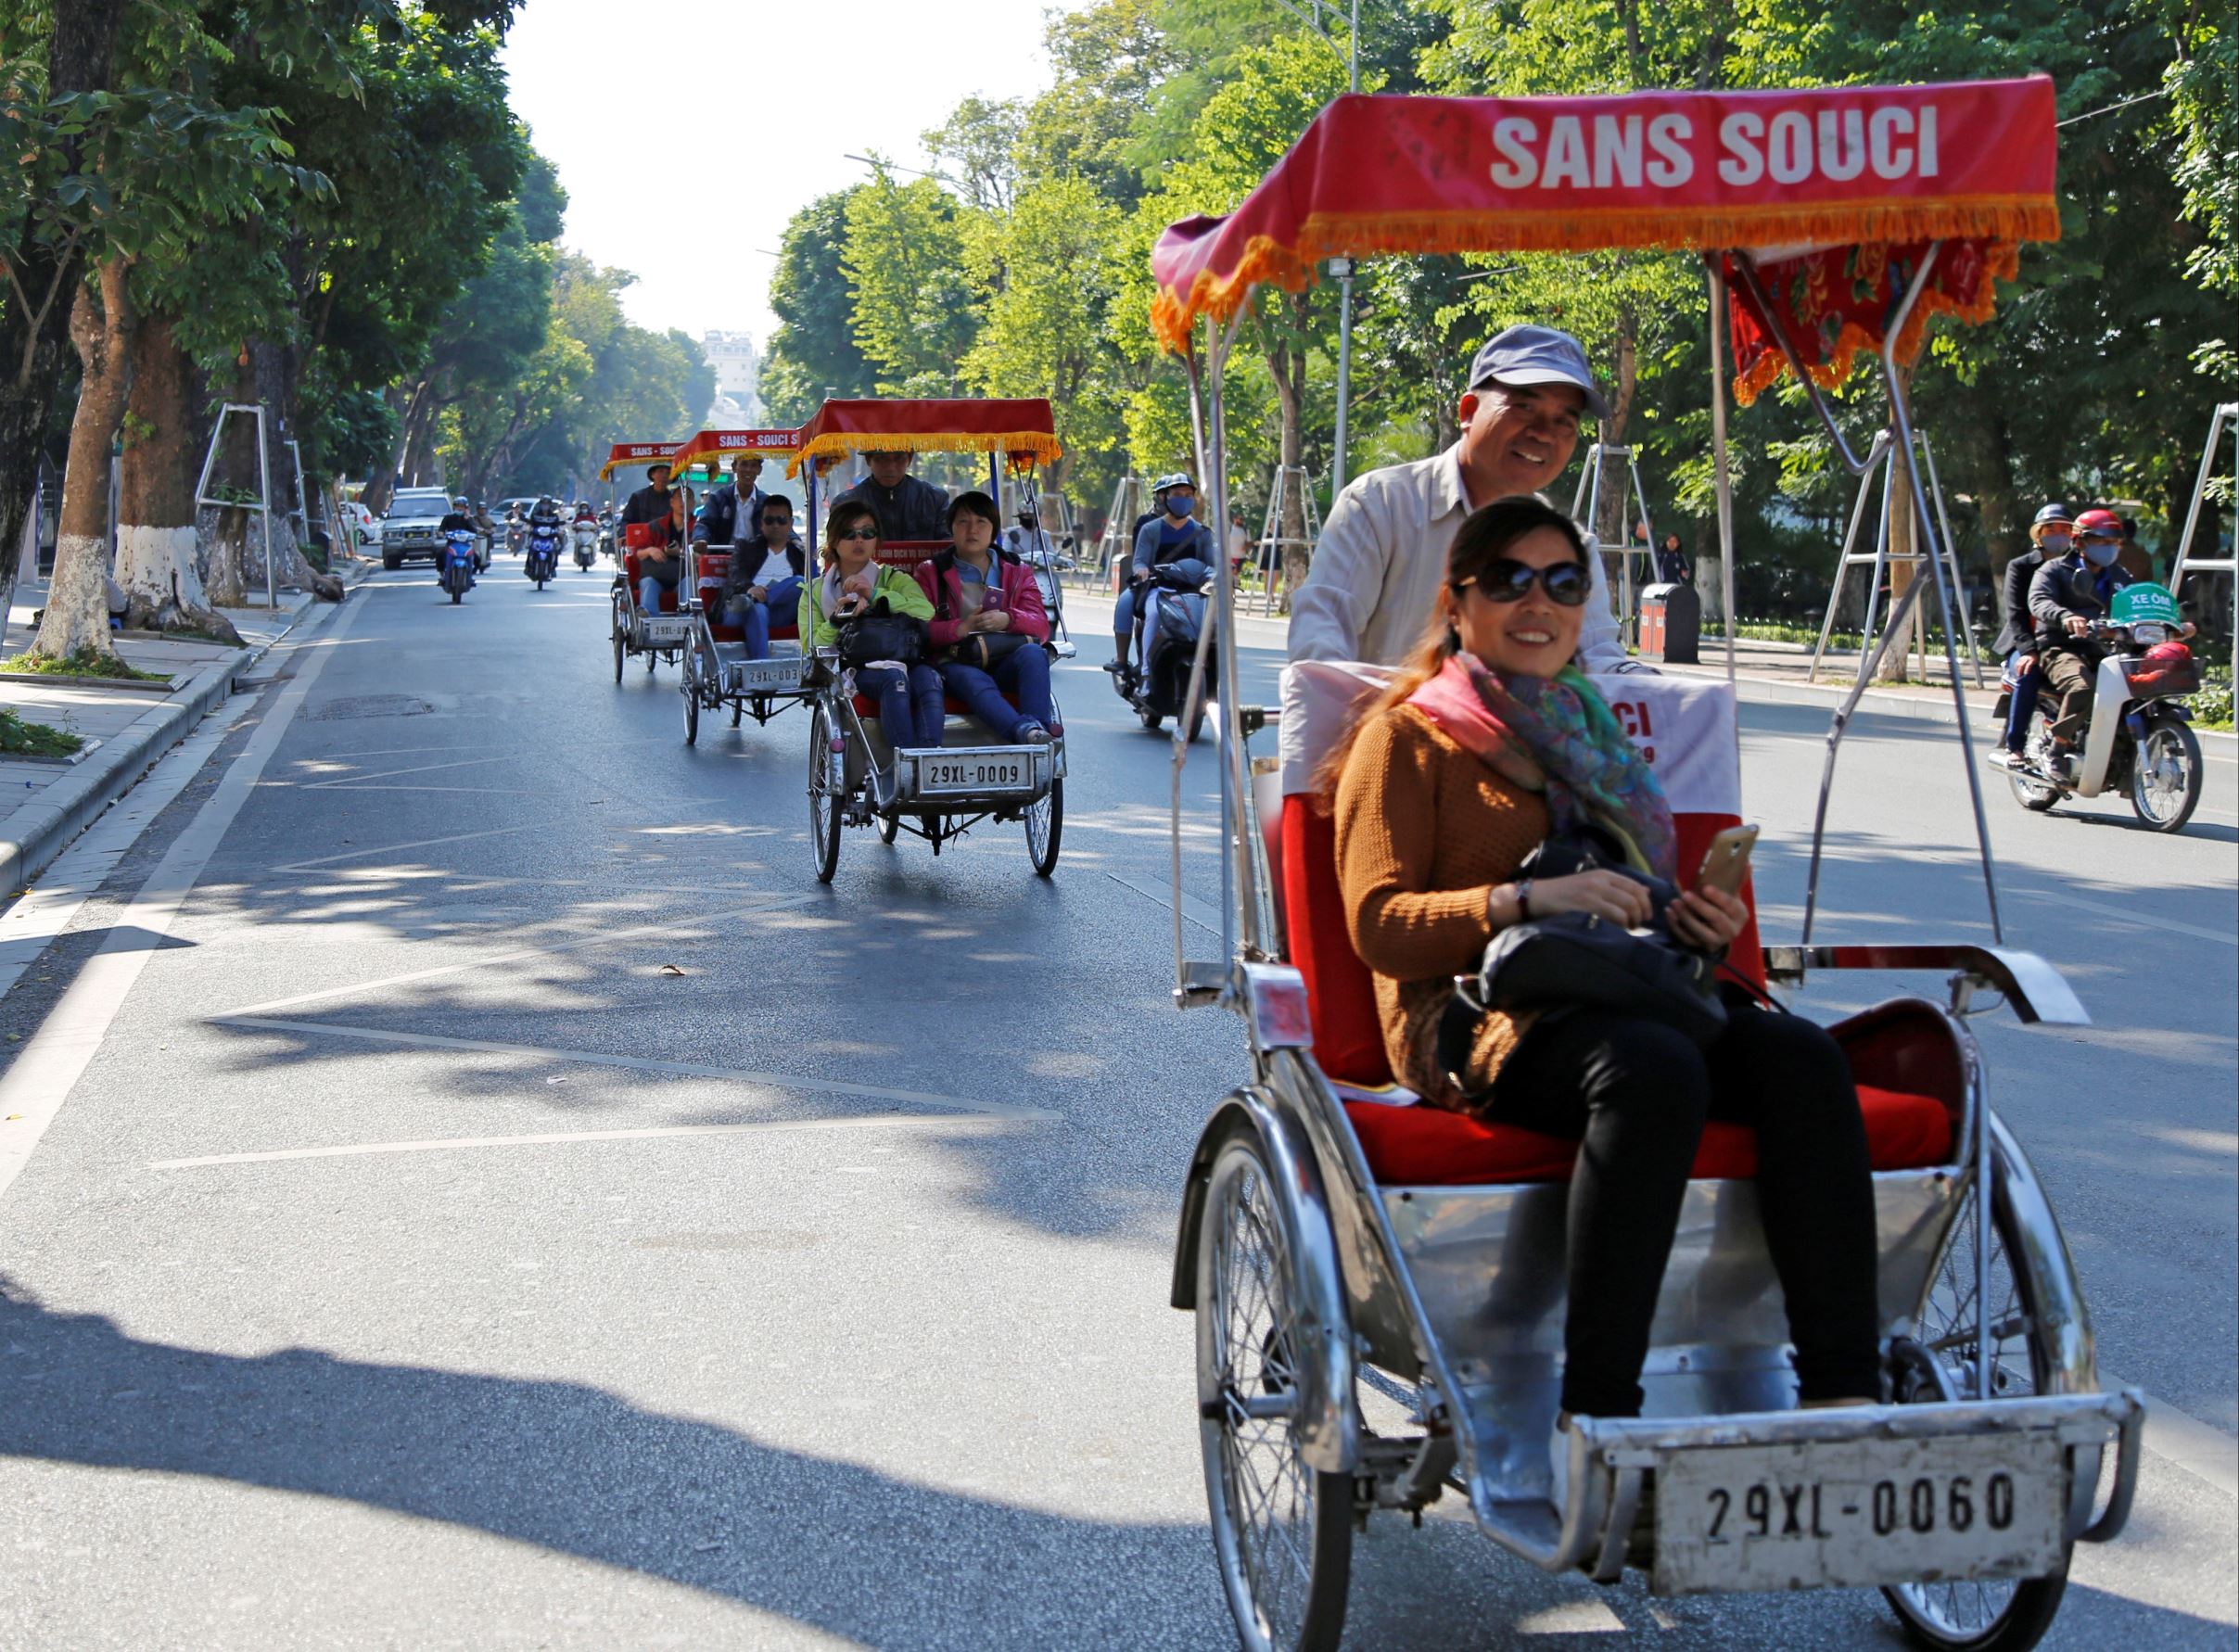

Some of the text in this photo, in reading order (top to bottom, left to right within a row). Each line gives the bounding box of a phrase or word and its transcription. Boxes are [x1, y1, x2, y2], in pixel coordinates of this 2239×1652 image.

[1490, 106, 1939, 189] SANS SOUCI
[719, 434, 747, 447] SANS
[757, 434, 788, 446] SOUCI
[631, 446, 653, 456] SANS
[2130, 592, 2171, 606] XE ÔM
[750, 668, 801, 683] 29XL-003
[931, 765, 1018, 783] 29XL-0009
[1707, 1472, 2015, 1544] 29XL-0060
